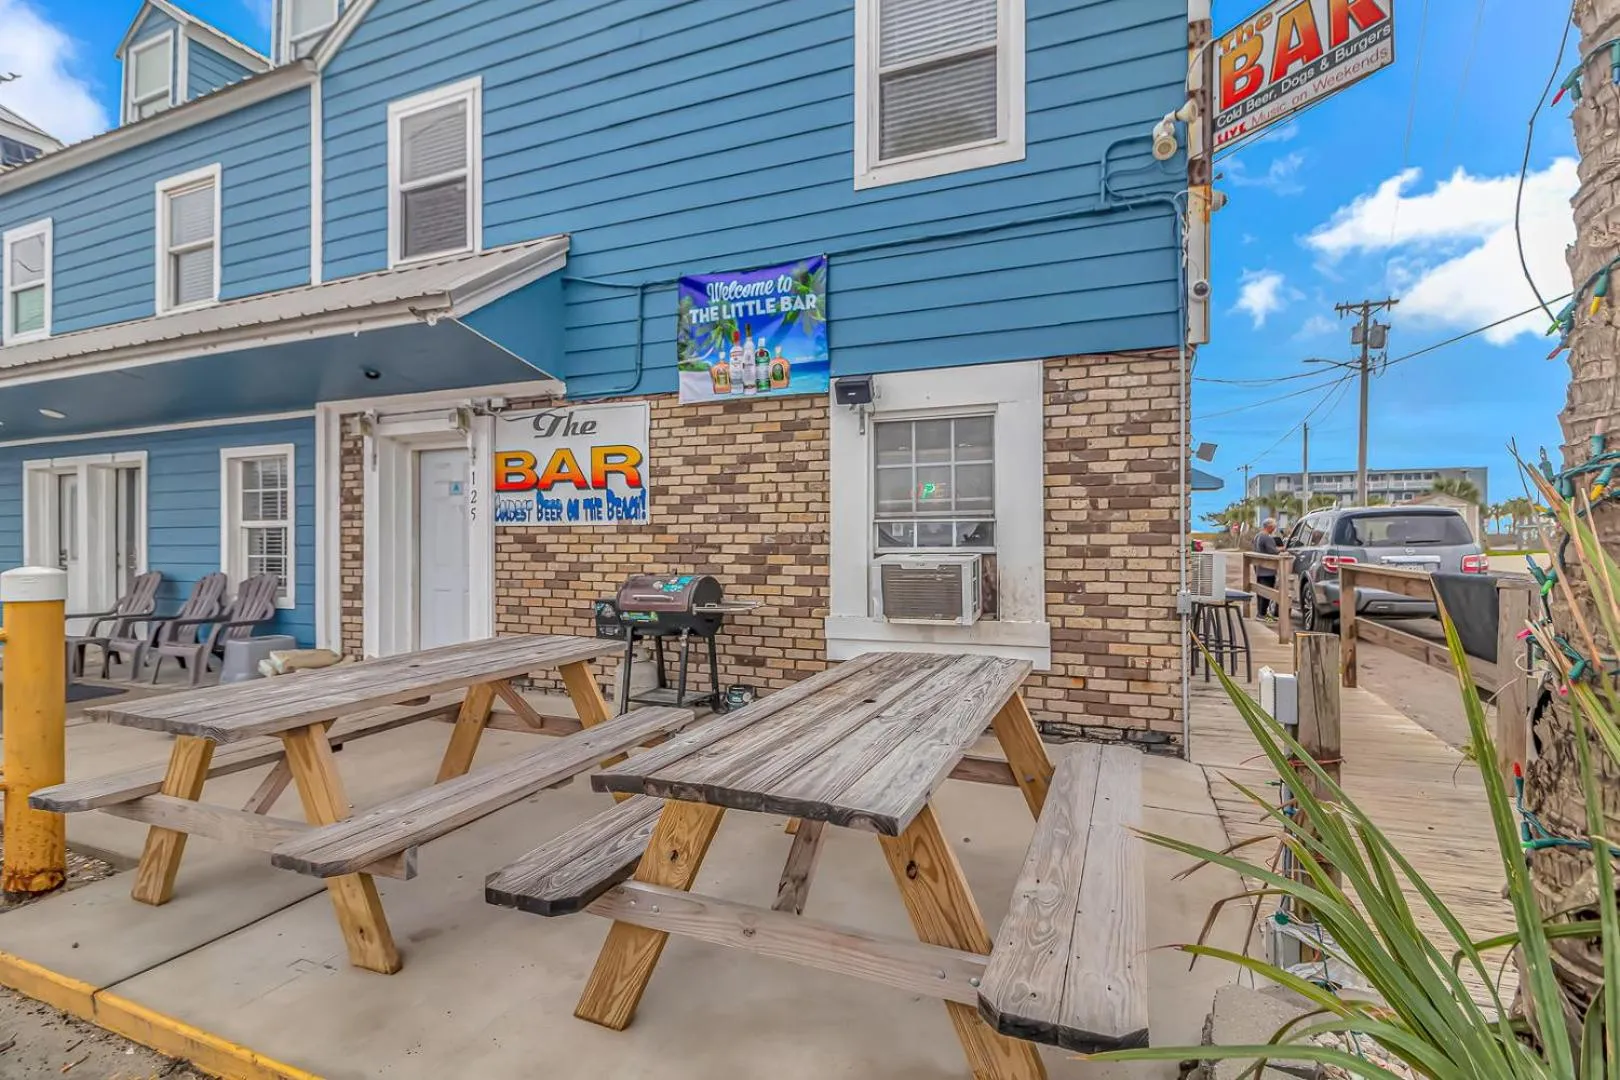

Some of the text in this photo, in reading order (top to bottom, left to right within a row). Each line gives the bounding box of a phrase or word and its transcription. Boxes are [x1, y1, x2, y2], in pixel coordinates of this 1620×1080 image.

[1217, 104, 1243, 128] Cold
[1281, 67, 1315, 94] Dogs
[1320, 57, 1330, 71] &
[1335, 24, 1391, 64] Burgers
[1217, 47, 1388, 145] LIVE Music on Weekends
[706, 274, 793, 302] Welcome to
[689, 294, 818, 324] THE LITTLE BAR
[533, 411, 597, 438] The
[494, 444, 644, 492] BAR
[470, 471, 478, 521] 125
[536, 490, 563, 522] BEER
[583, 497, 603, 521] THE
